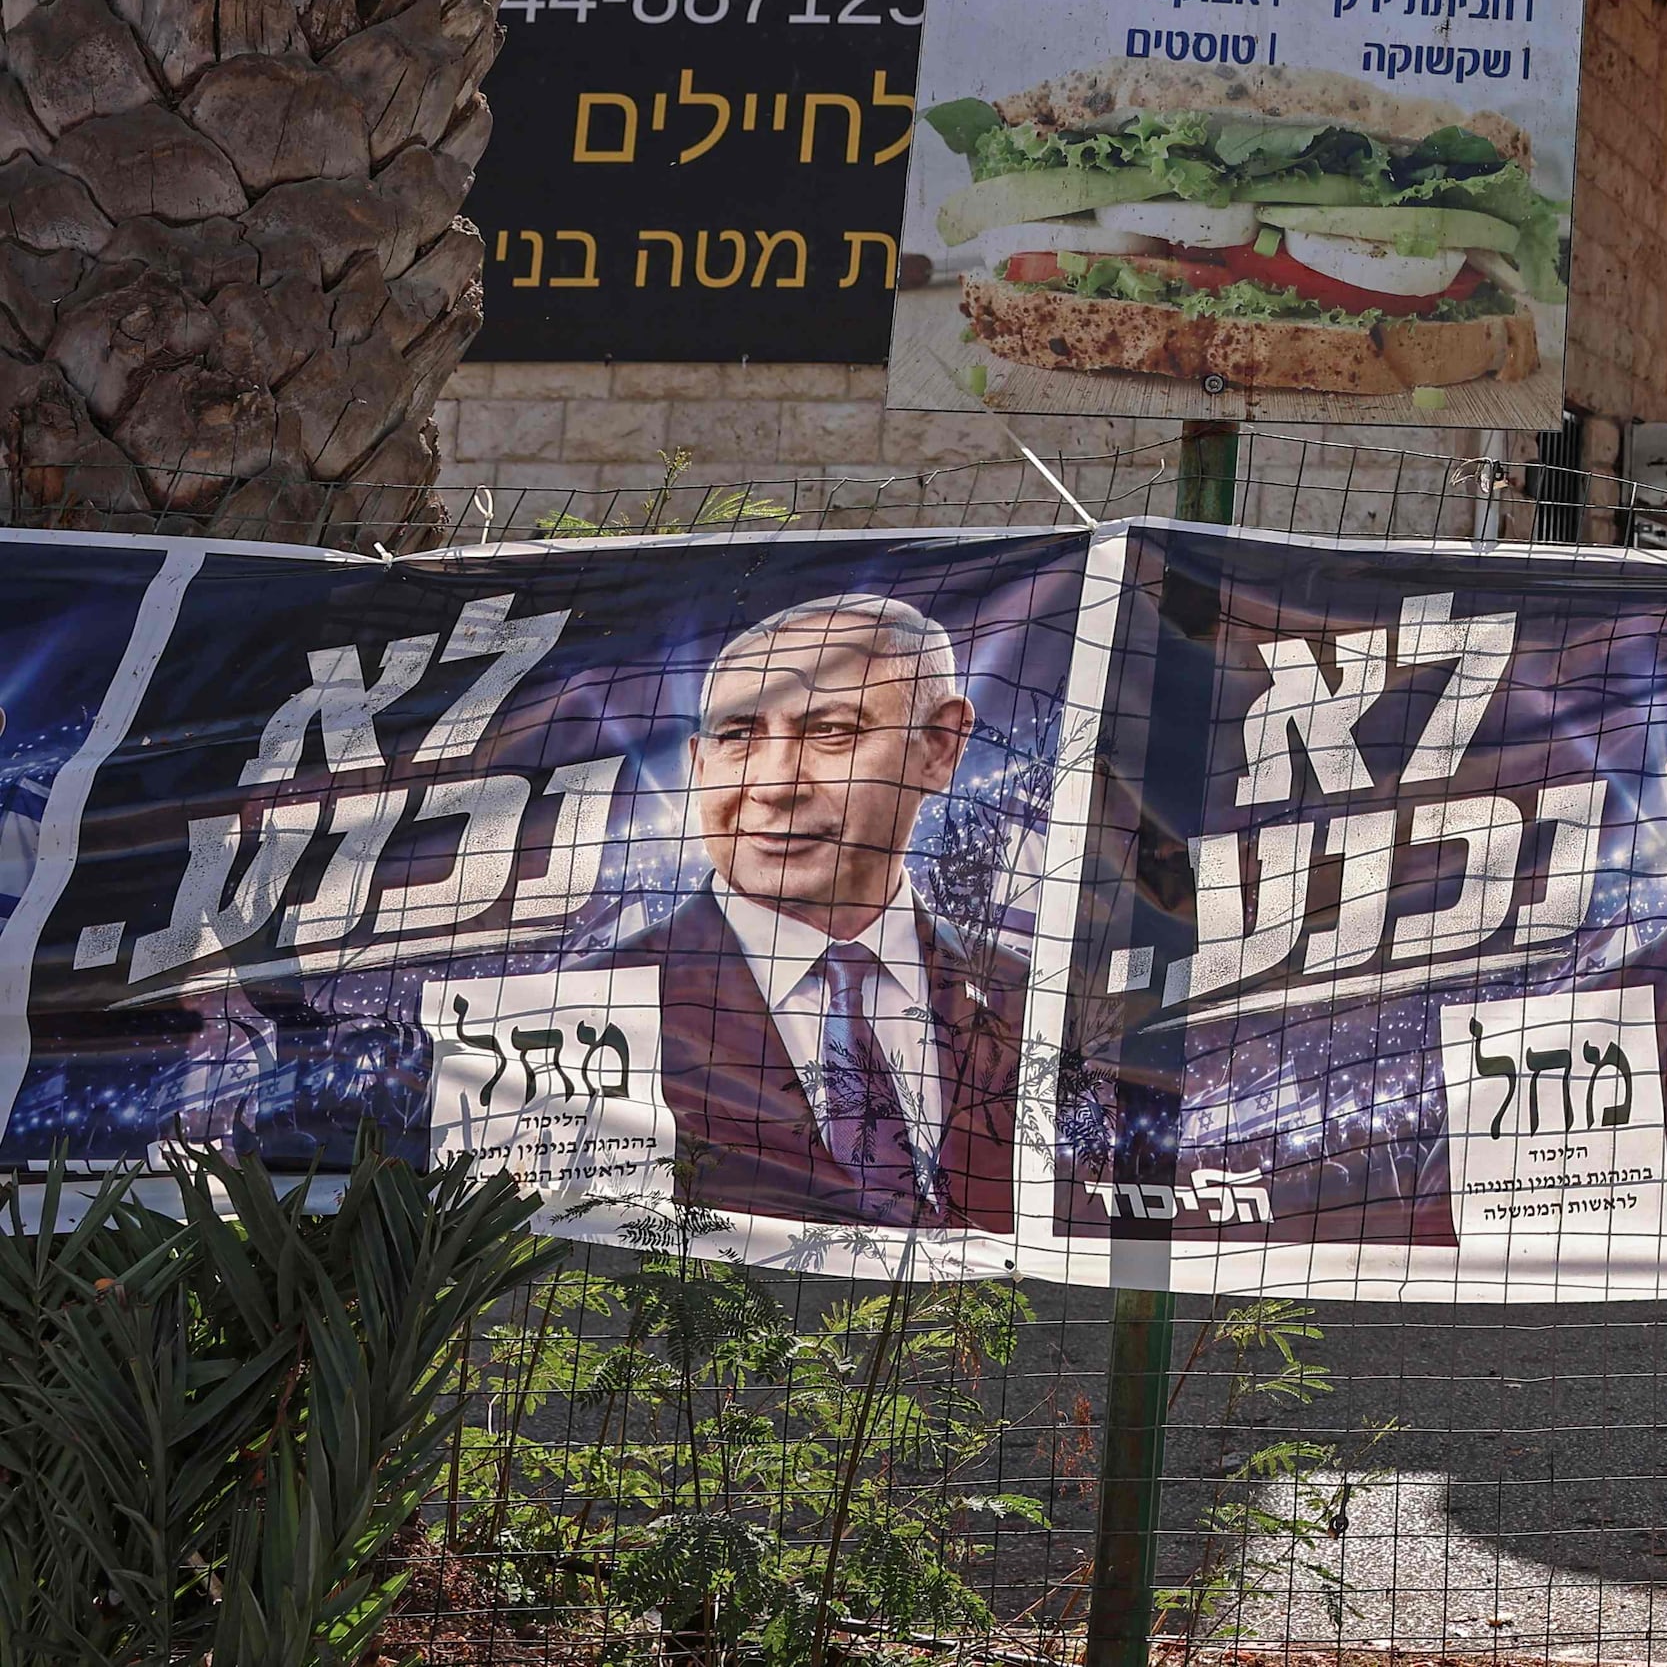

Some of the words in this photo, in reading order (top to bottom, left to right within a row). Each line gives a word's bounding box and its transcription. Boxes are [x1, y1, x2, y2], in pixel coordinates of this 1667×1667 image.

[1125, 26, 1257, 65] טוסטים
[1361, 40, 1512, 83] שקשוקה
[572, 68, 915, 167] לחיילים
[634, 230, 808, 289] מטה
[246, 592, 572, 787] לא
[1236, 591, 1518, 807] לא
[1107, 780, 1608, 1010] נכנע.
[452, 992, 630, 1107] מחל
[1469, 1016, 1633, 1141] מחל
[520, 1111, 588, 1130] הליכוד
[517, 1140, 578, 1160] בנימין
[583, 1135, 658, 1153] בהנהגת
[1528, 1143, 1589, 1163] הליכוד
[559, 1159, 638, 1182] לראשות
[1528, 1173, 1582, 1193] בנימין
[1586, 1165, 1654, 1185] בהנהגת
[1084, 1167, 1275, 1223] הליכוד
[1466, 1178, 1523, 1197] נתניהו
[1483, 1200, 1563, 1222] הממשלה
[1567, 1193, 1638, 1215] לראשות
